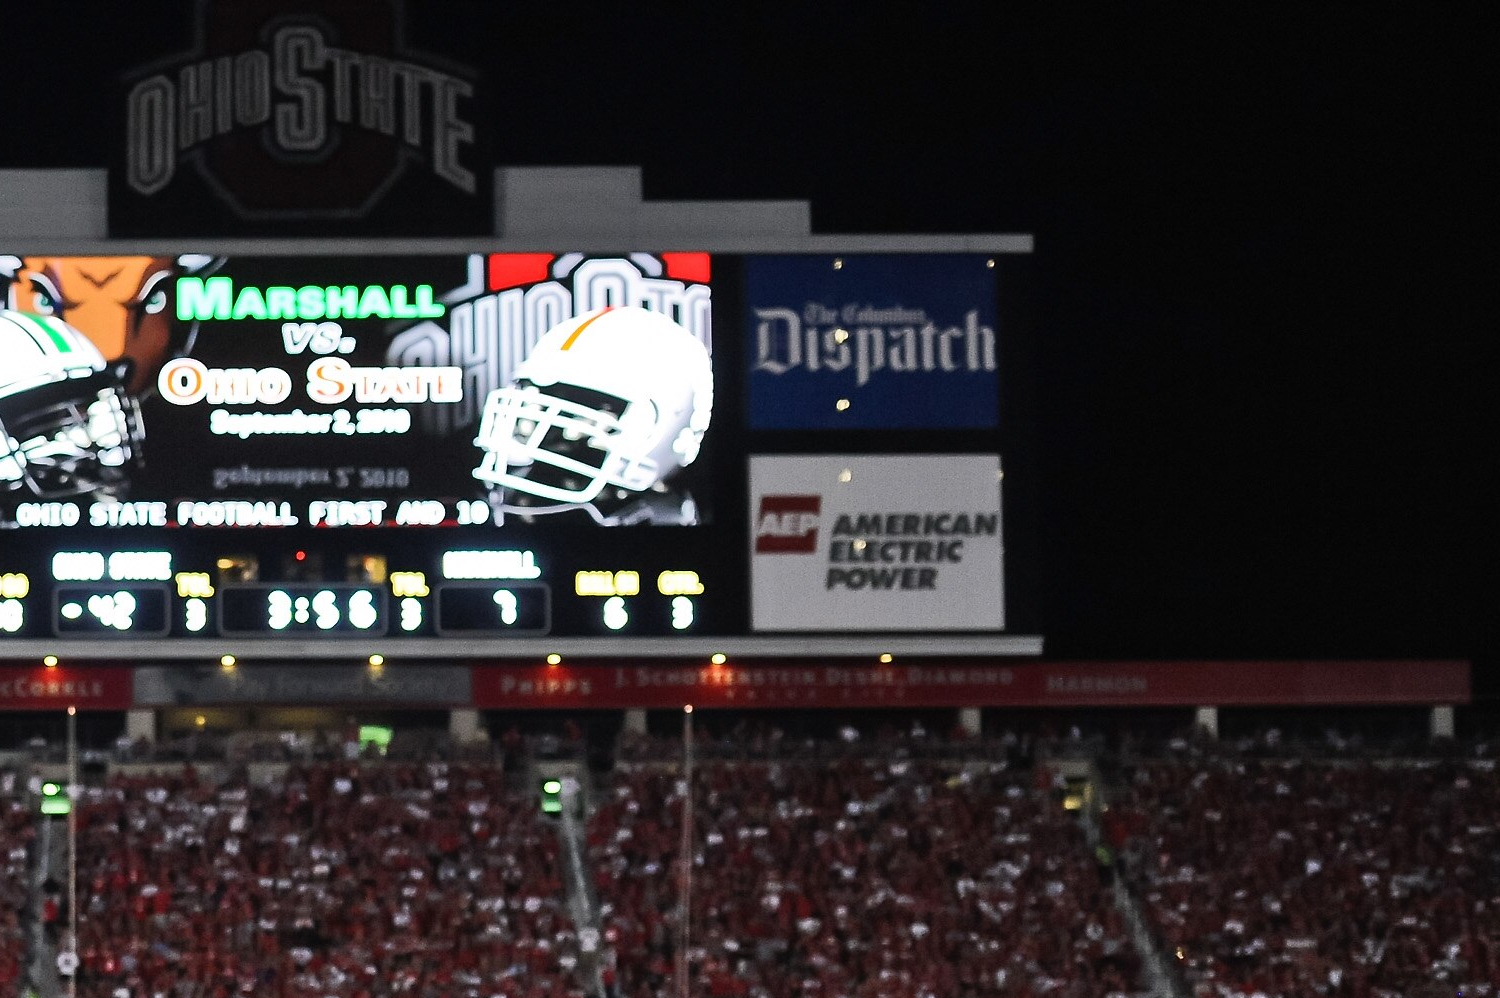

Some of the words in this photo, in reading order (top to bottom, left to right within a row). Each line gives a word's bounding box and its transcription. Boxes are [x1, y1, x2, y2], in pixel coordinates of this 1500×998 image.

[126, 50, 271, 196] OHIO
[273, 26, 477, 195] STATE
[754, 309, 997, 387] Dispatch
[16, 502, 80, 526] OHIO
[90, 502, 168, 526] STATE
[177, 502, 298, 526] FOOTBALL
[309, 501, 387, 526] FIRST
[457, 501, 490, 525] 10
[832, 514, 998, 538] AMERICAN
[829, 540, 965, 564] ELECTRIC
[827, 567, 938, 591] POWER
